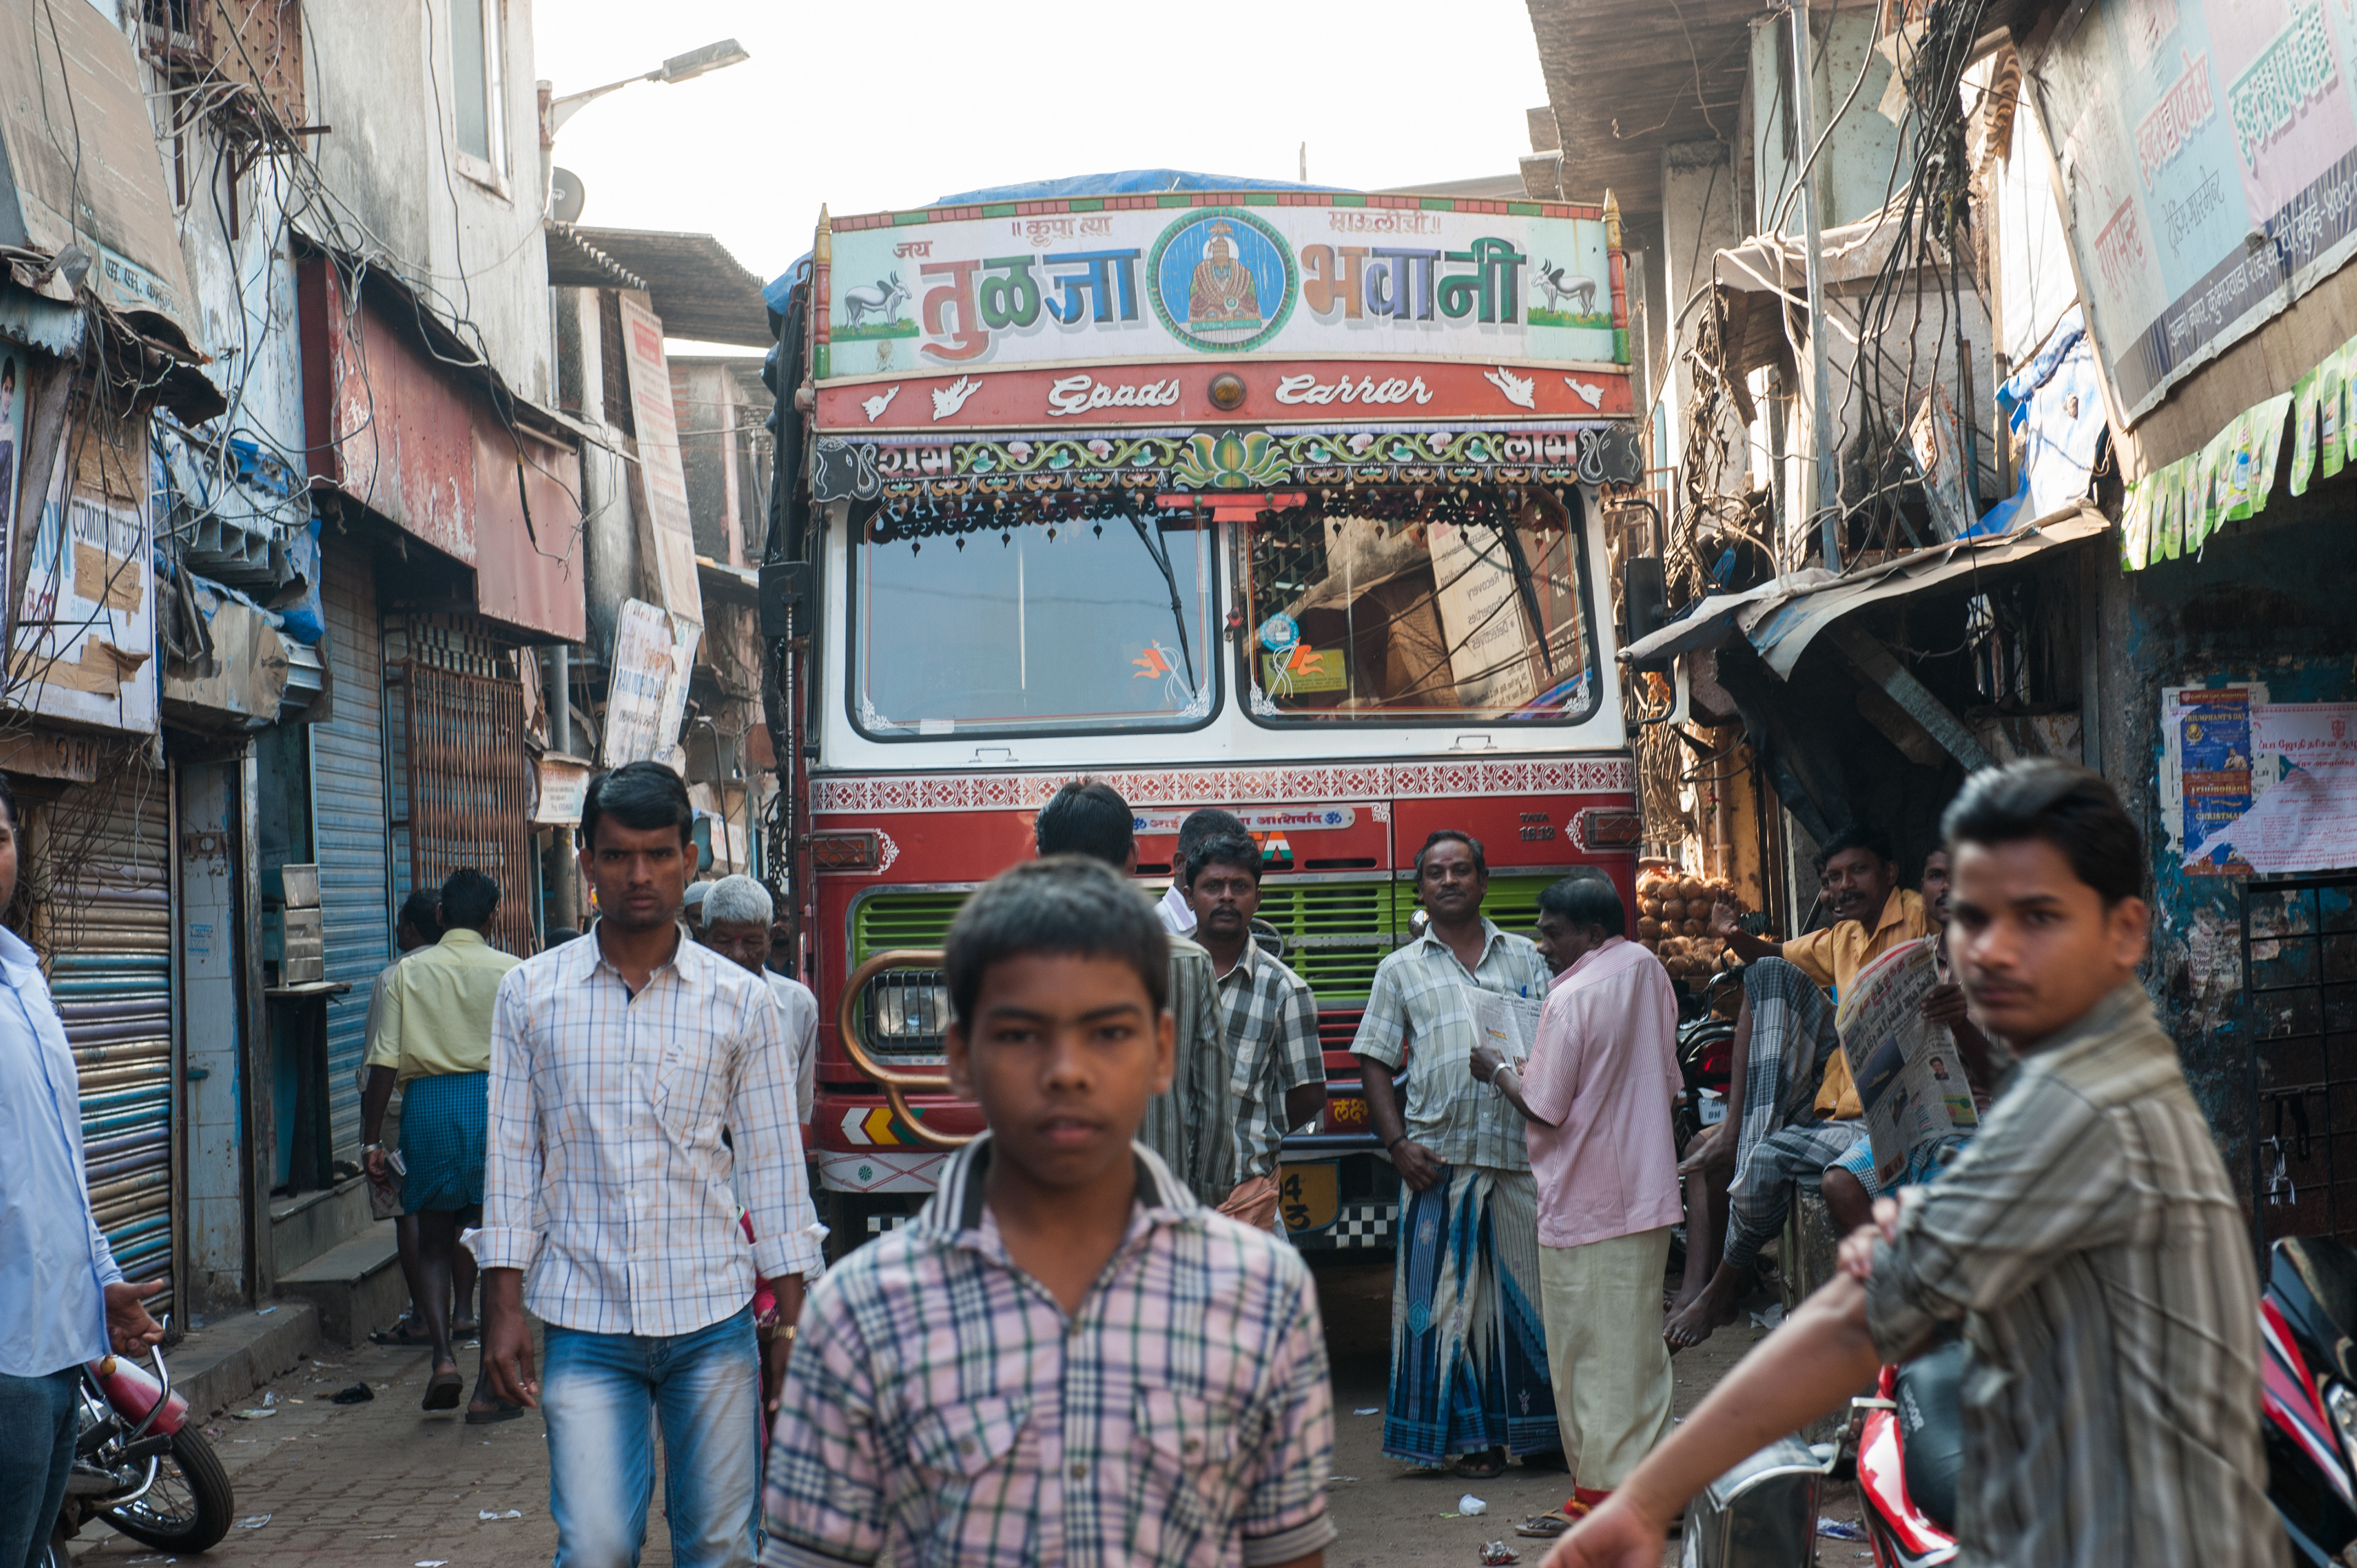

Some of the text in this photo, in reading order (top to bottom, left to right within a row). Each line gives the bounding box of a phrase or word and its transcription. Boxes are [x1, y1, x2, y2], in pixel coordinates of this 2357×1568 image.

[892, 240, 933, 259] जय
[919, 236, 1528, 361] तुळजा भवानी
[1274, 373, 1434, 405] Carrier
[878, 443, 953, 478] शुभ
[1503, 430, 1577, 464] लाभ
[1520, 812, 1549, 823] TATA
